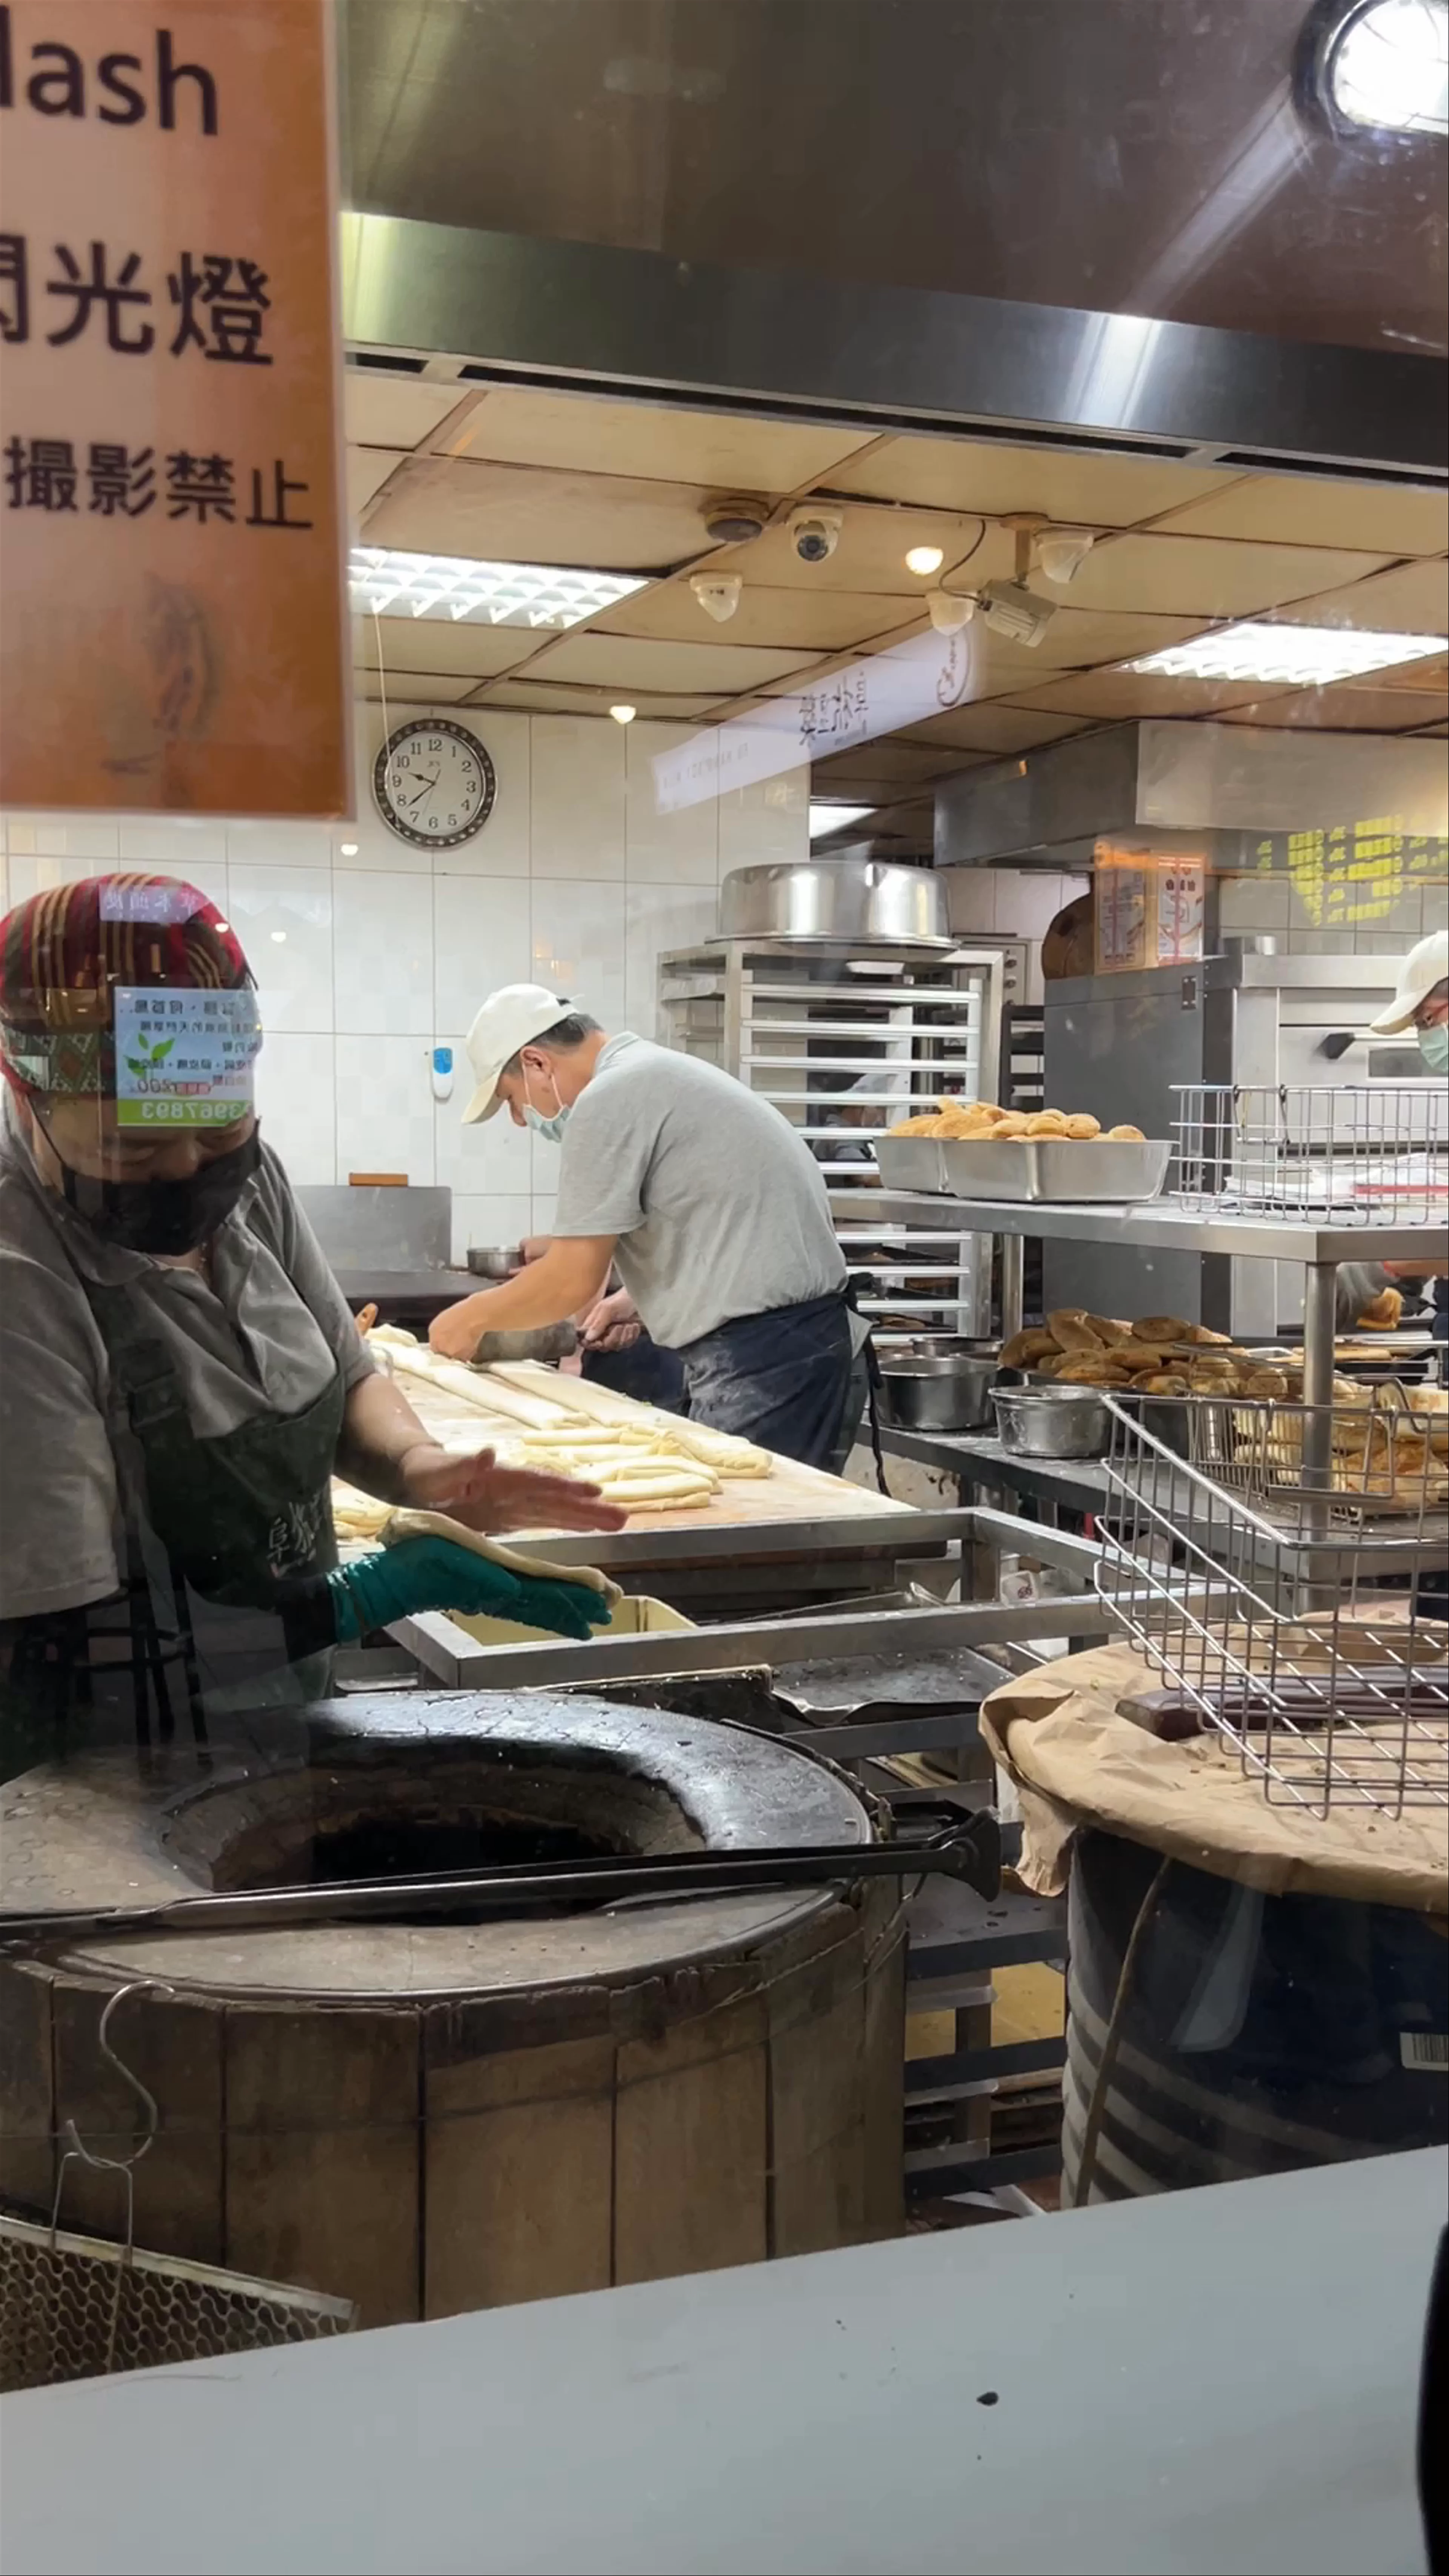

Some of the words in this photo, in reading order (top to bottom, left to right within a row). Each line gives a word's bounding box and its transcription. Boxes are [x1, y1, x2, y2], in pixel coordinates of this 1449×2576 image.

[5, 435, 314, 529] 撮影禁止
[411, 742, 421, 755] 11
[428, 738, 443, 752] 12
[452, 746, 456, 757] 1
[397, 756, 410, 768] 10
[461, 760, 472, 773] 2
[392, 775, 402, 787] 9
[466, 781, 476, 793] 3
[397, 794, 407, 806] 8
[461, 799, 470, 811] 4
[410, 811, 420, 823] 7
[429, 816, 438, 829] 6
[448, 814, 457, 826] 5
